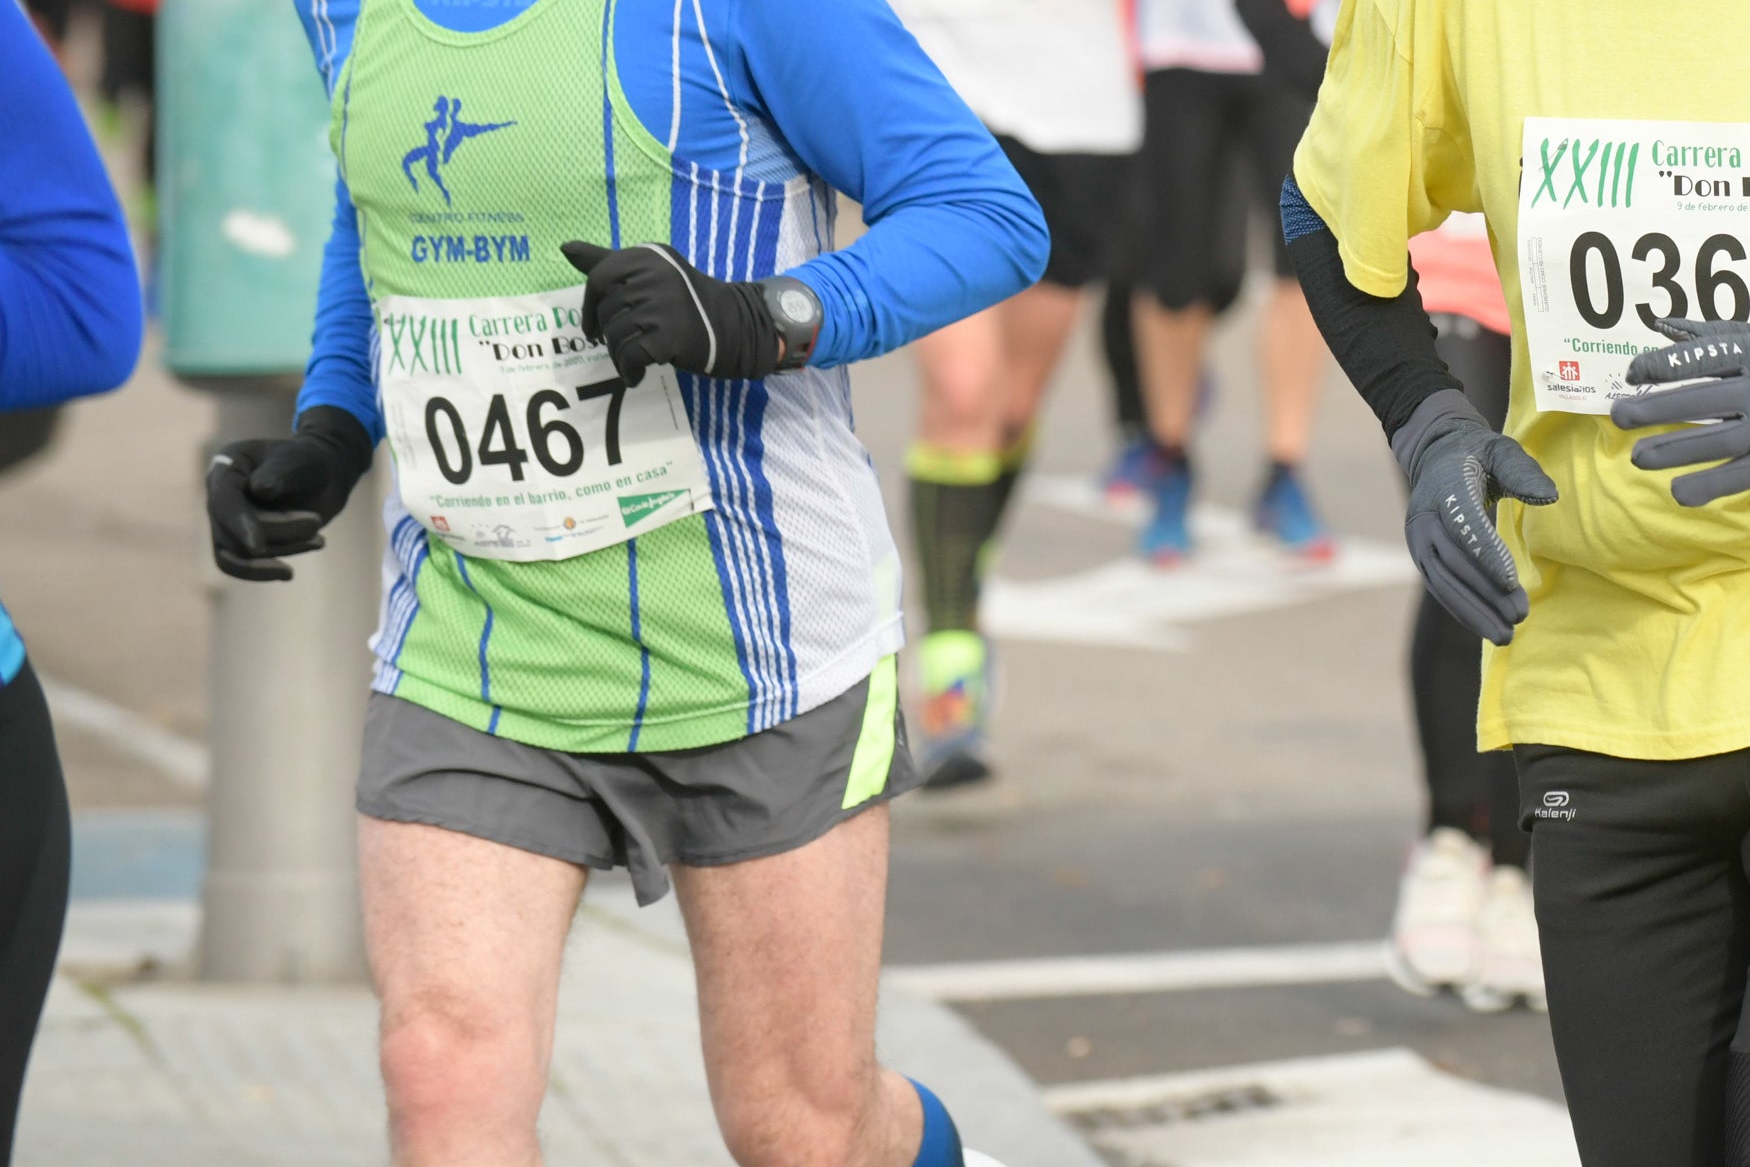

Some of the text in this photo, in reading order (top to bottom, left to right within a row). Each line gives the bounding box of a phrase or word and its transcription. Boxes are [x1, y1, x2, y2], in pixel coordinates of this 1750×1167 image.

[1652, 140, 1741, 168] Carrera
[1532, 138, 1639, 209] XXIII
[1676, 201, 1683, 210] 9
[1685, 202, 1696, 211] de
[1737, 202, 1749, 212] de
[412, 235, 531, 263] GYM-BYM
[469, 312, 547, 337] Carrera
[388, 313, 462, 375] XXIII
[1667, 342, 1743, 368] KIPSTA
[424, 377, 628, 485] 0467
[496, 495, 510, 506] en
[514, 494, 524, 505] el
[528, 491, 572, 505] barrio,
[576, 483, 611, 497] como
[616, 477, 632, 489] en
[1445, 494, 1482, 556] KIPSTA
[1534, 808, 1577, 822] Kalenji
